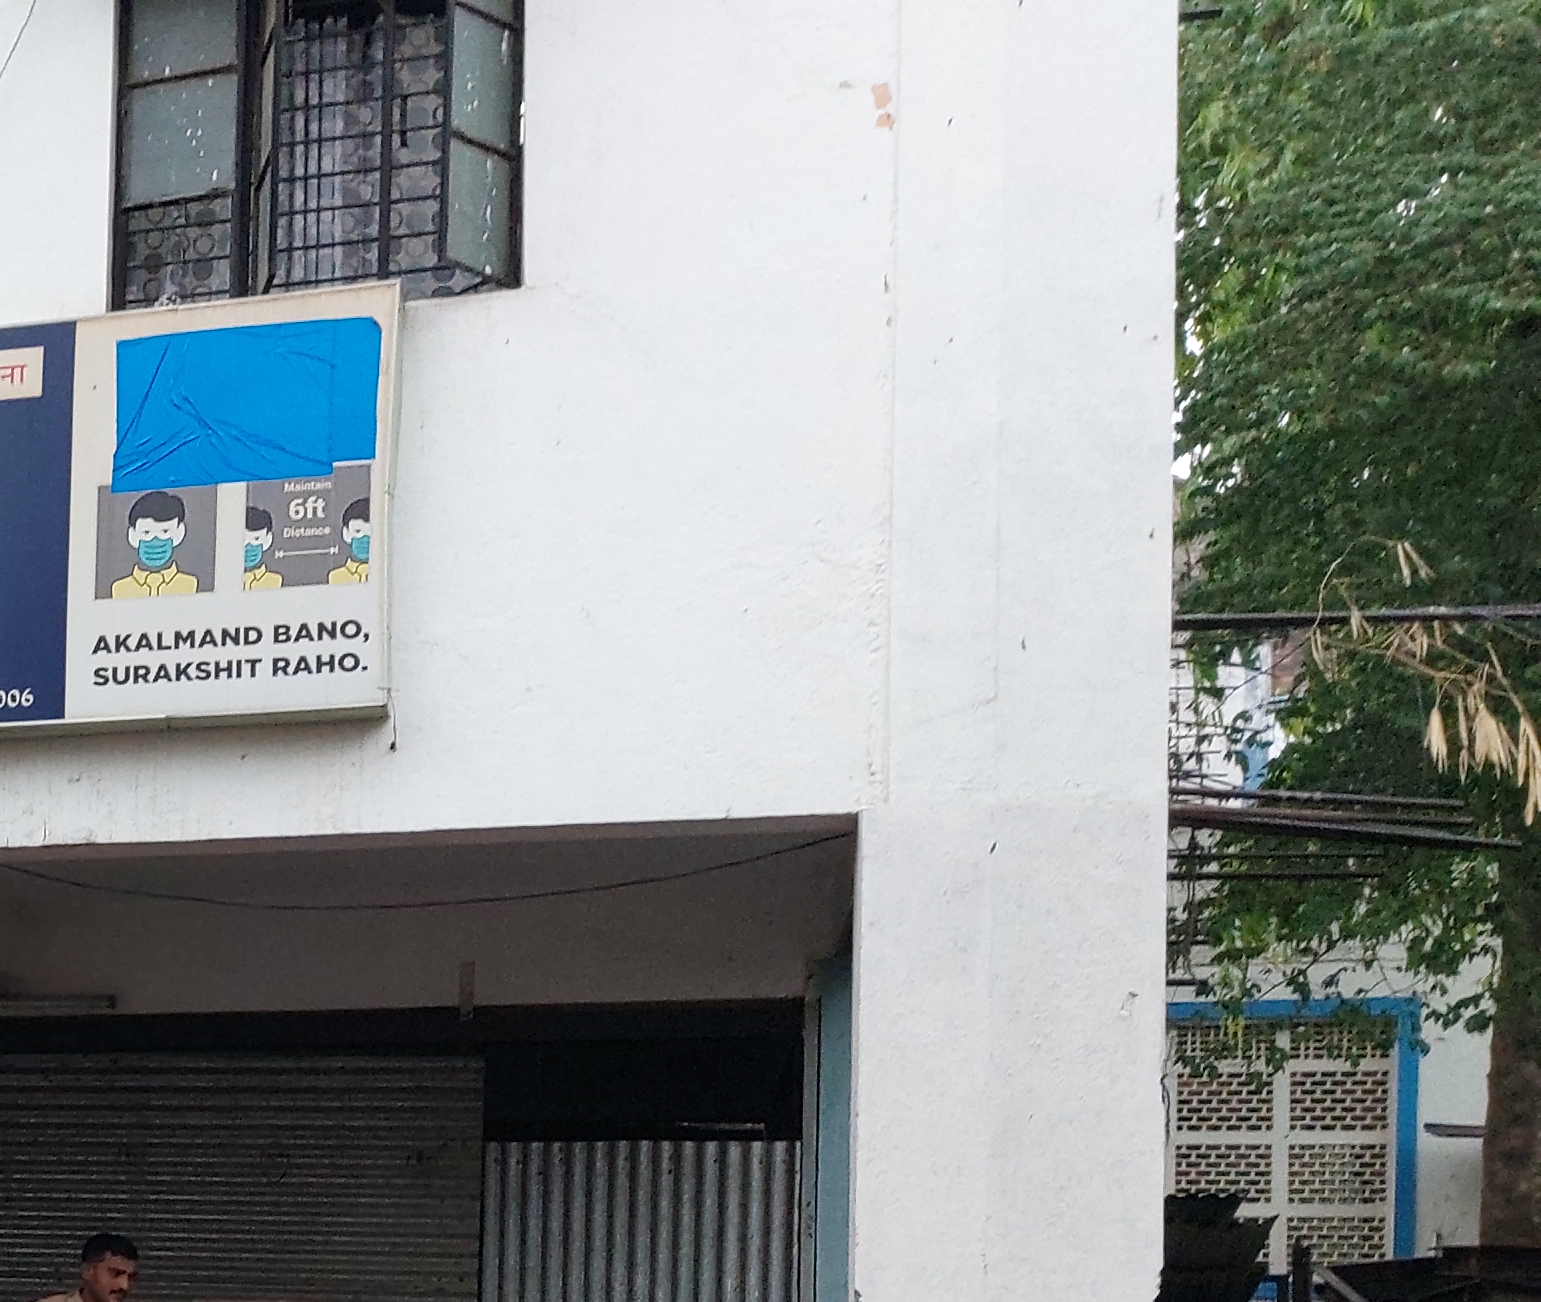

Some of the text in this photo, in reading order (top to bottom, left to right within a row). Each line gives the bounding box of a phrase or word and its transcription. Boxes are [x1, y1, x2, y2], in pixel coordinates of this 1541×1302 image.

[283, 479, 333, 494] Maintain
[288, 496, 326, 521] 6ft
[282, 524, 332, 540] Distance
[91, 618, 371, 656] AKALMAND BANO,
[92, 652, 369, 687] SURAKSHIT RAHO.
